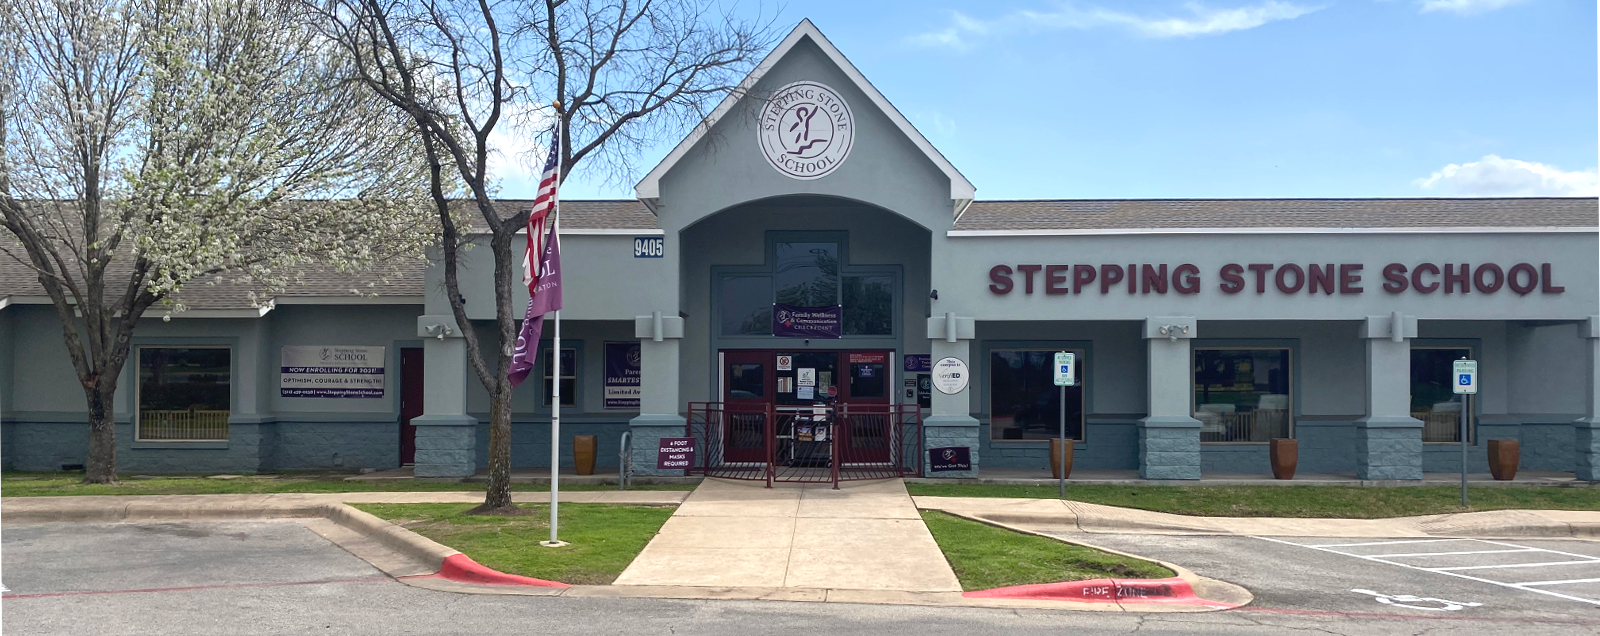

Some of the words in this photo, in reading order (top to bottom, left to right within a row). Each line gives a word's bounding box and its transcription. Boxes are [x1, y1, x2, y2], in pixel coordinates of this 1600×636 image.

[765, 89, 814, 131] STEPPING
[817, 92, 847, 131] STONE
[777, 153, 835, 173] SCHOOL
[635, 238, 663, 256] 9405
[988, 263, 1200, 294] STEPPING
[1219, 262, 1364, 294] STONE
[1382, 262, 1566, 295] SCHOOL
[334, 353, 368, 361] SCHOOL
[1083, 586, 1110, 597] FIRE
